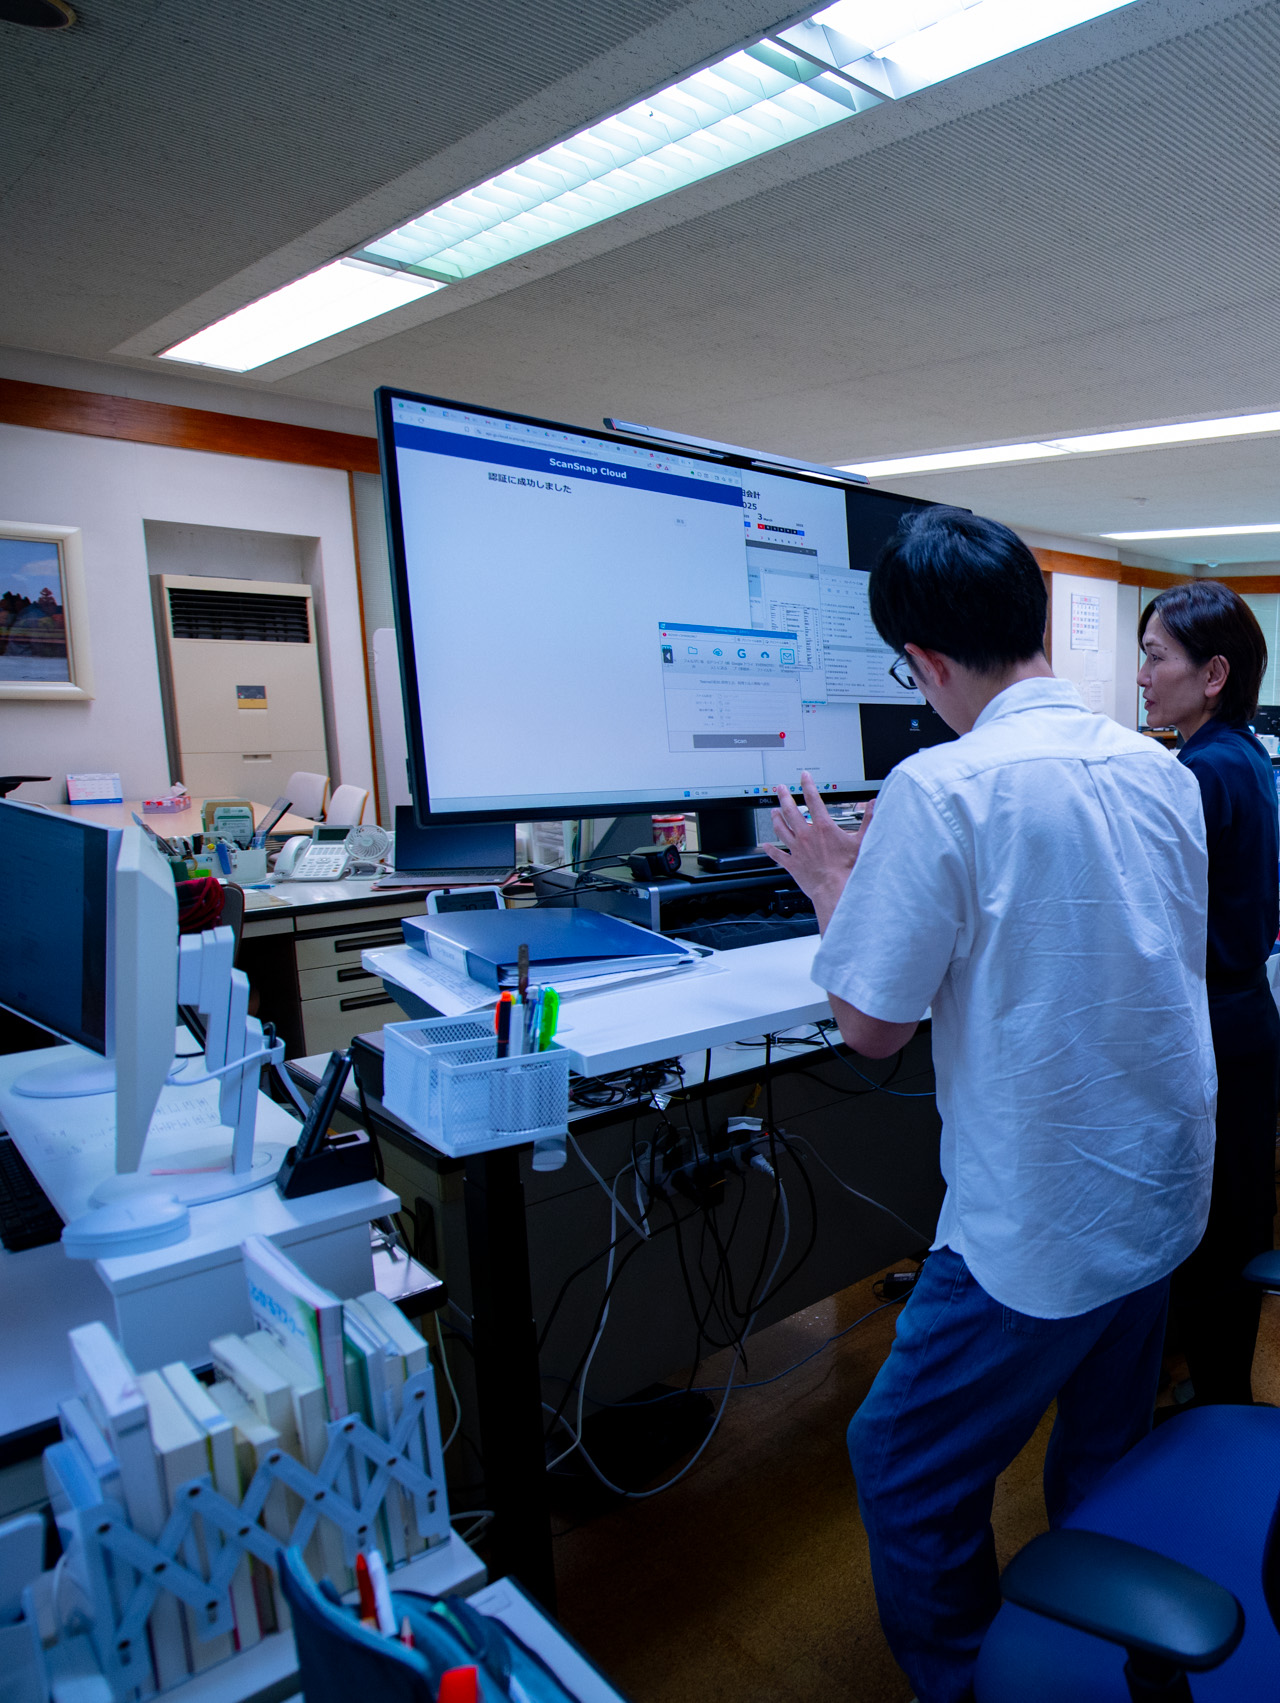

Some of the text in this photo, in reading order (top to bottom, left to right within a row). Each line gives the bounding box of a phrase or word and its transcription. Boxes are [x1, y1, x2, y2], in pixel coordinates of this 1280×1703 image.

[549, 457, 627, 479] ScanSnap Cloud
[488, 472, 572, 494] 認証に成功しました
